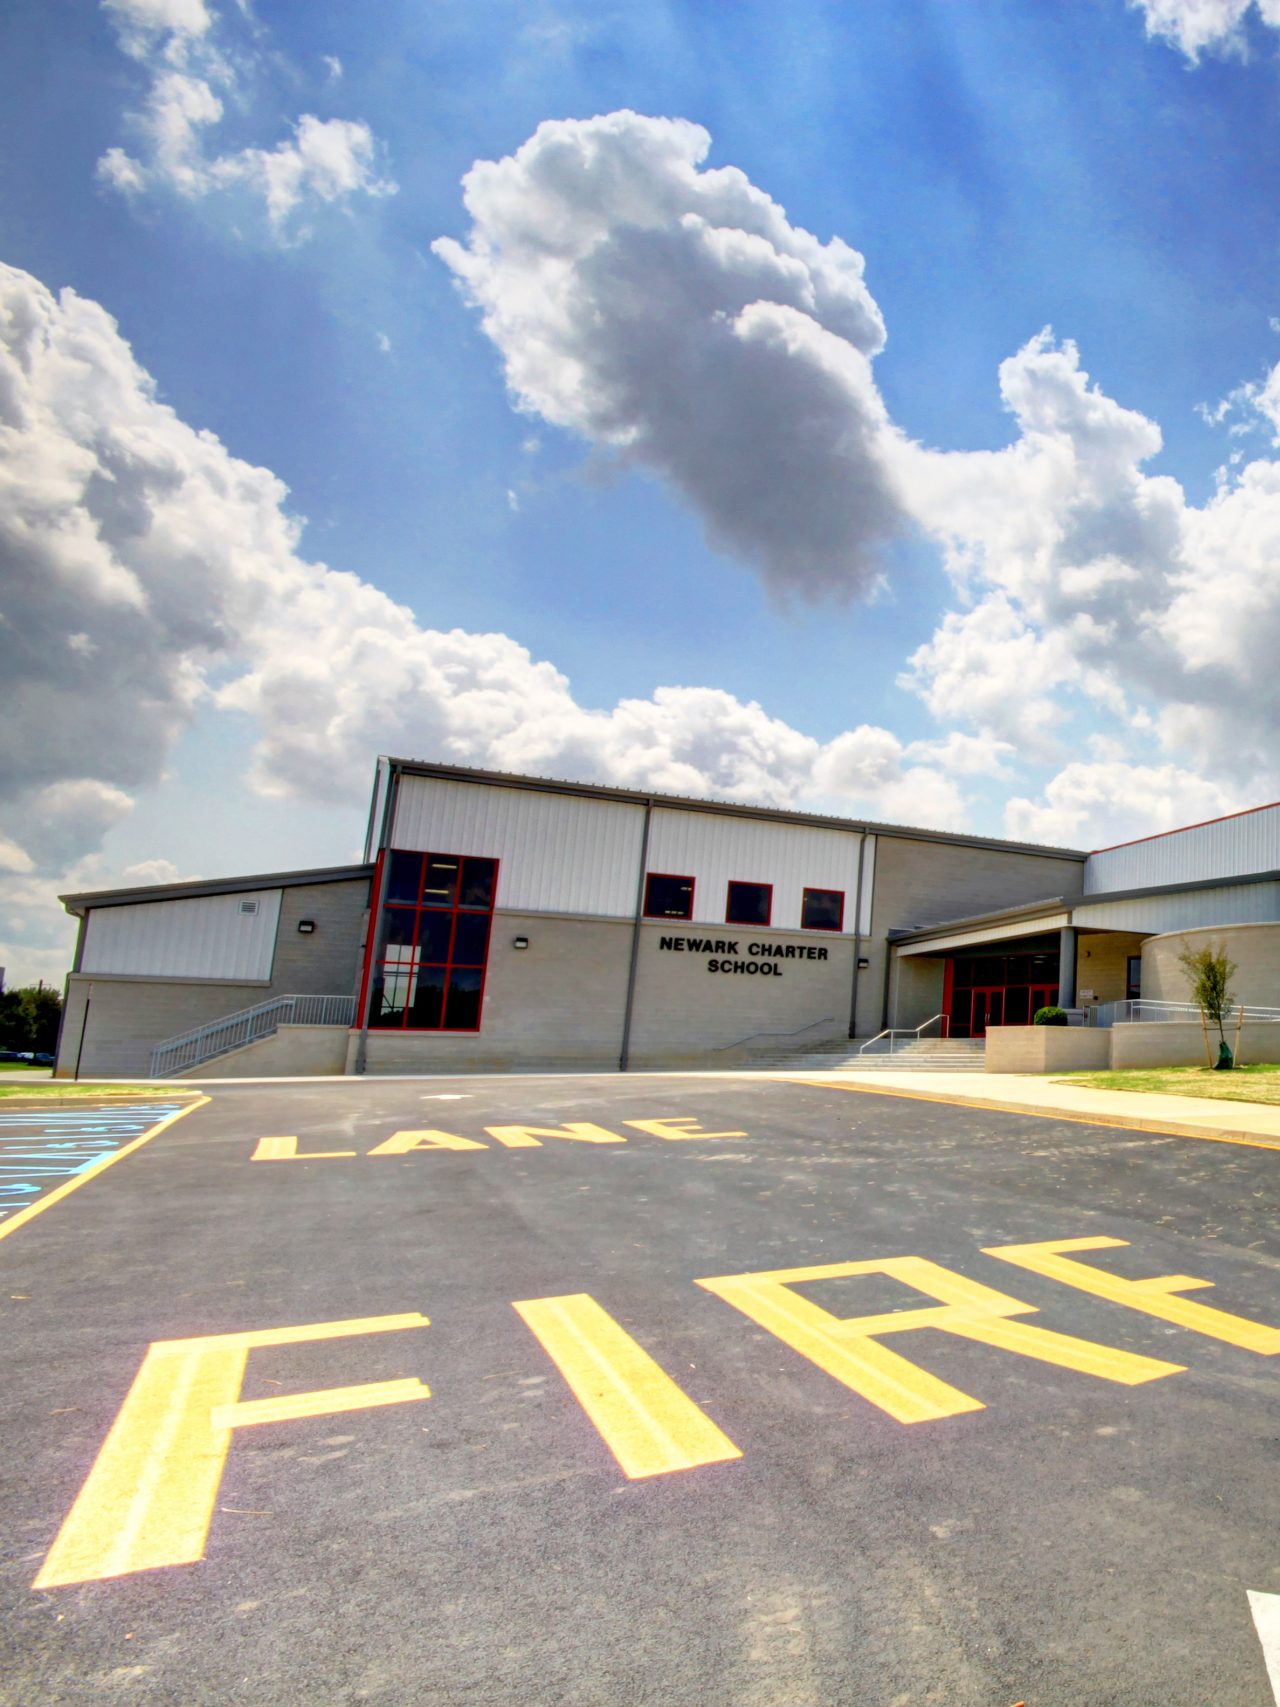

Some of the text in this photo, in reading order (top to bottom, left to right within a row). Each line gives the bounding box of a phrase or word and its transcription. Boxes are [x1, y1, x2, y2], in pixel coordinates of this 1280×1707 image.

[660, 936, 828, 960] NEWARK CHARTER
[707, 959, 783, 976] SCHOOL
[250, 1117, 748, 1161] LANE
